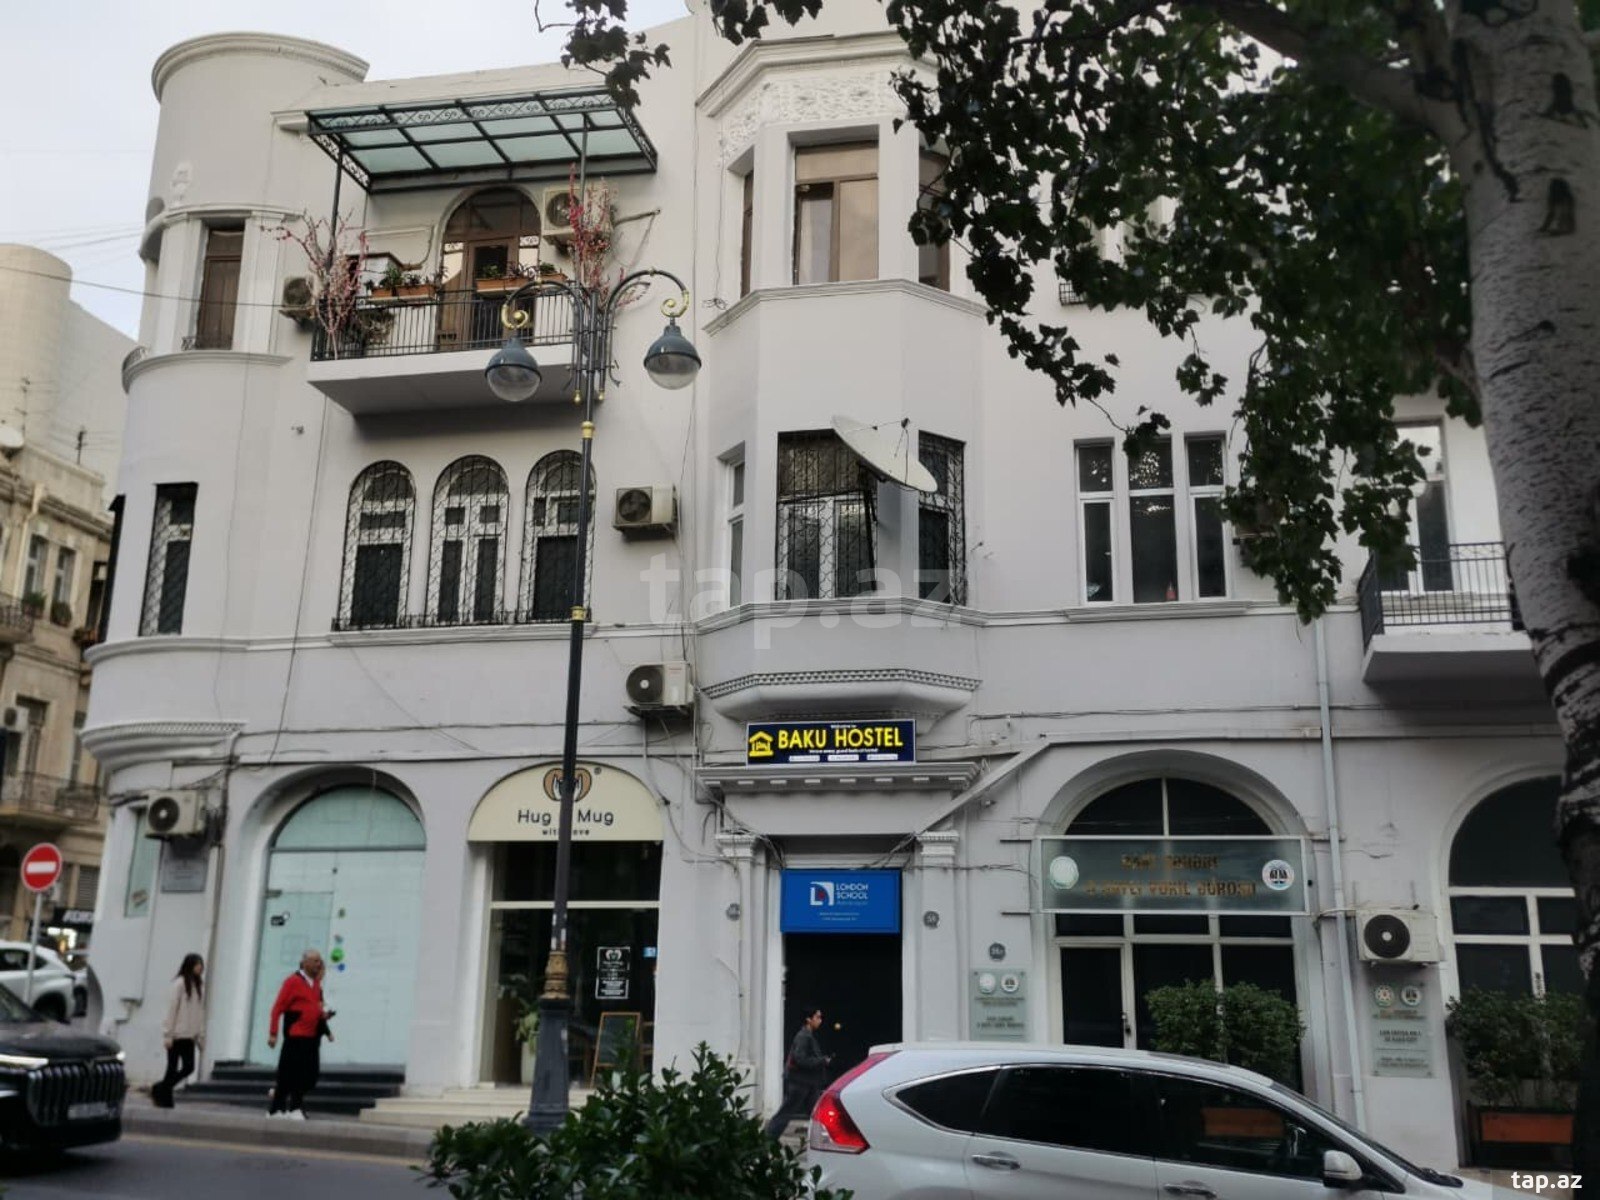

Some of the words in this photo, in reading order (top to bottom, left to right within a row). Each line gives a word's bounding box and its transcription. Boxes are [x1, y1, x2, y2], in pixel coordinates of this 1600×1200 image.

[777, 729, 827, 750] BAKU
[834, 727, 904, 748] HOSTEL
[517, 809, 552, 826] Hug
[577, 809, 614, 827] Mug
[835, 883, 869, 891] LONDON
[835, 892, 869, 900] SCHOOL
